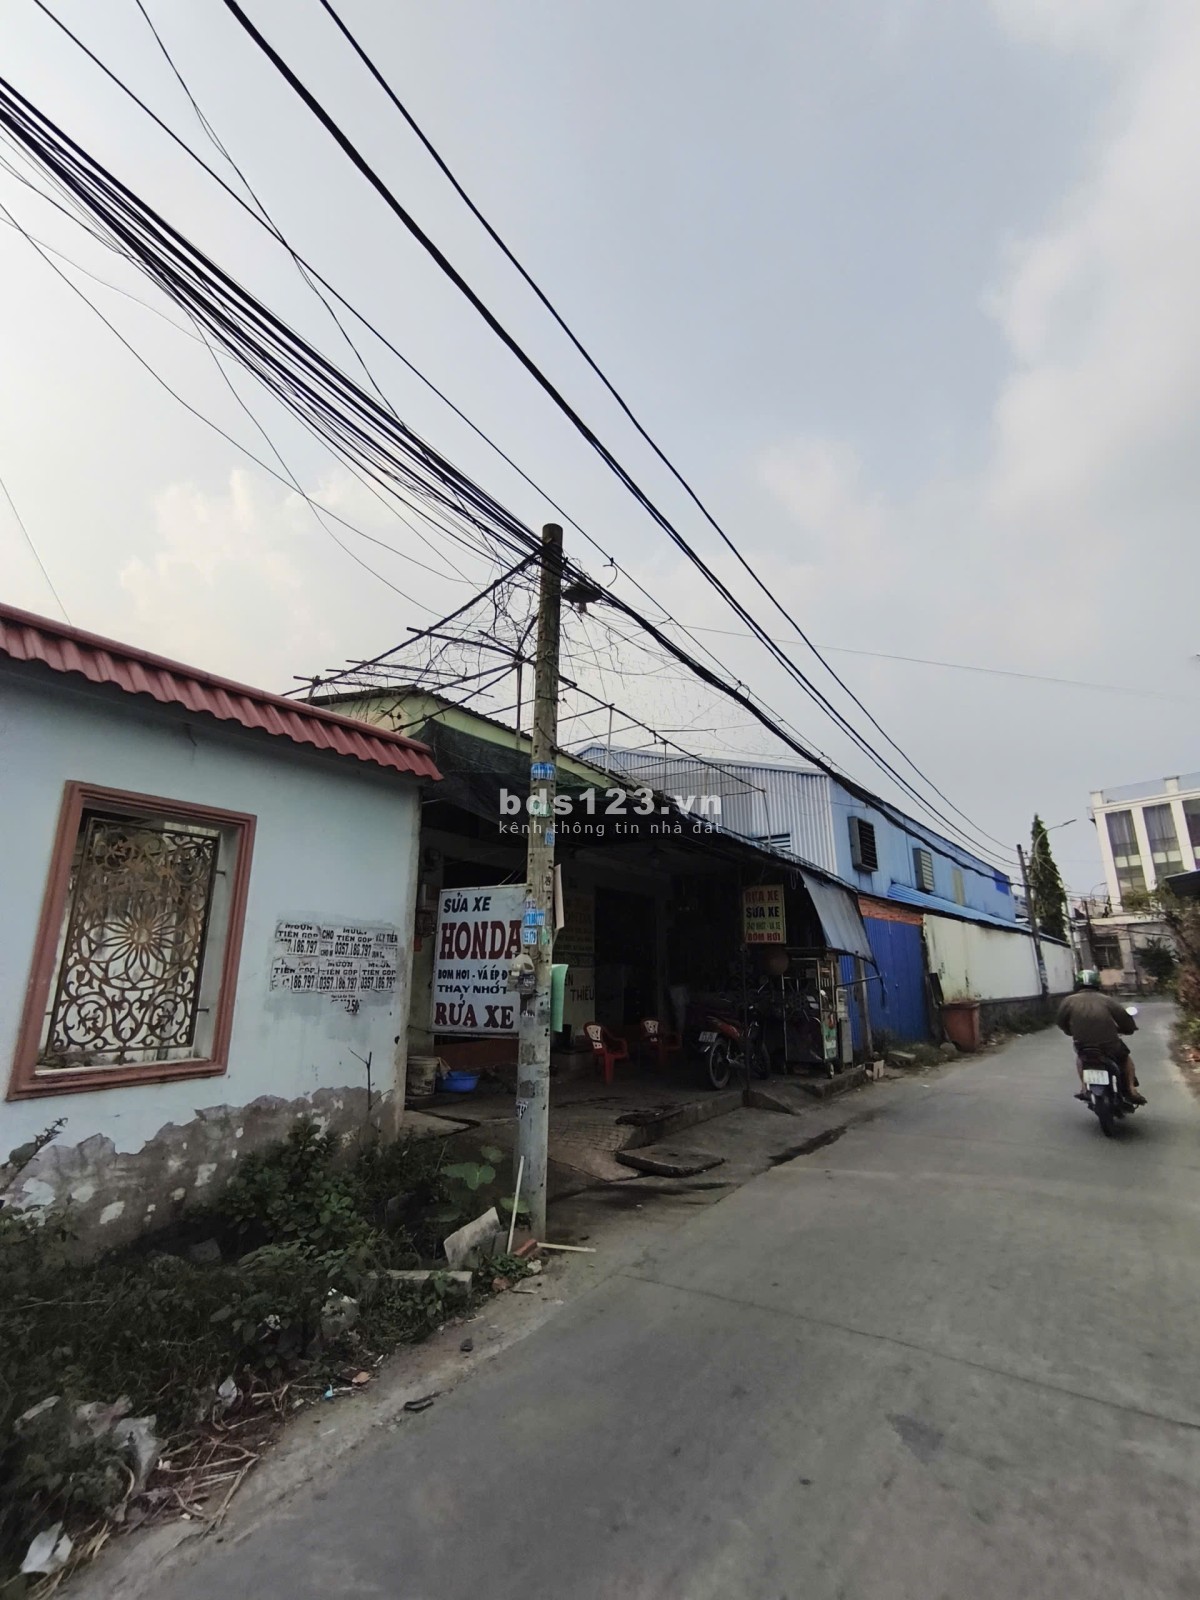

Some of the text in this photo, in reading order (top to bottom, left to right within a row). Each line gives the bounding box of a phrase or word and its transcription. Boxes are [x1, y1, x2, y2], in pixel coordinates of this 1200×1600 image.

[472, 896, 491, 912] XE
[440, 919, 522, 960] HONDA
[484, 1005, 514, 1030] XE
